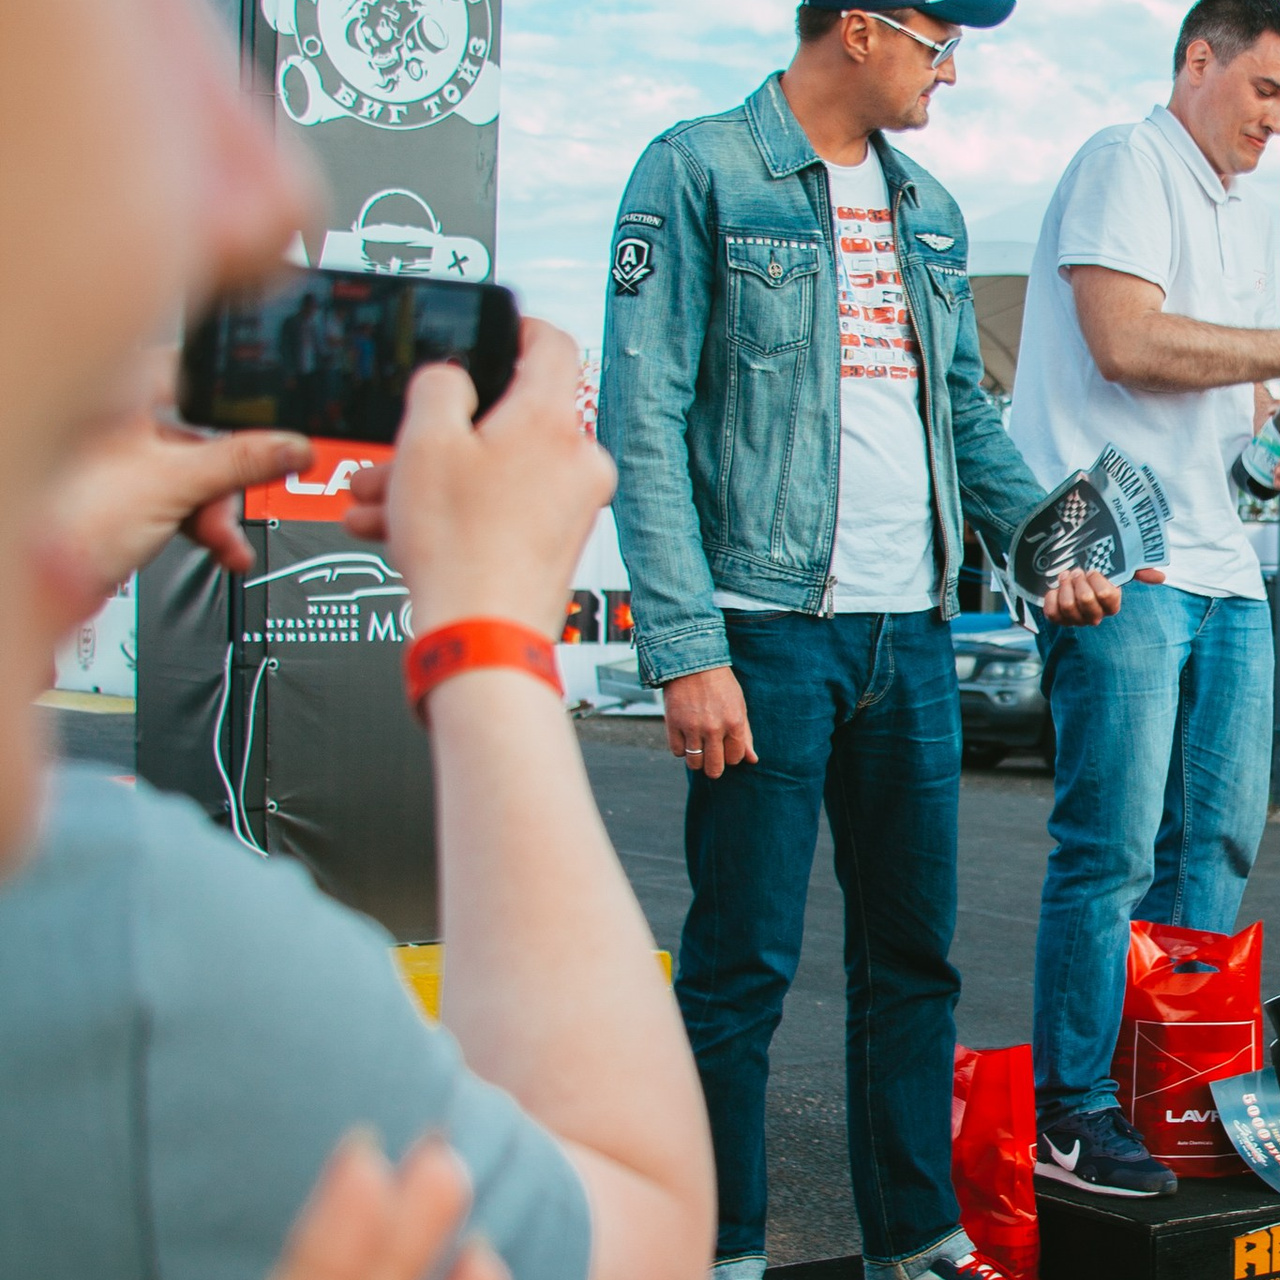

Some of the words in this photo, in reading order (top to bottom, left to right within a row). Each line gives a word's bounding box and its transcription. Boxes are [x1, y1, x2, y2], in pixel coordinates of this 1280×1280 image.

[333, 82, 408, 124] БИГ
[424, 37, 487, 118] ТОЙЗ
[1101, 449, 1146, 502] RUSSIAN
[1131, 496, 1165, 563] WEEKEND
